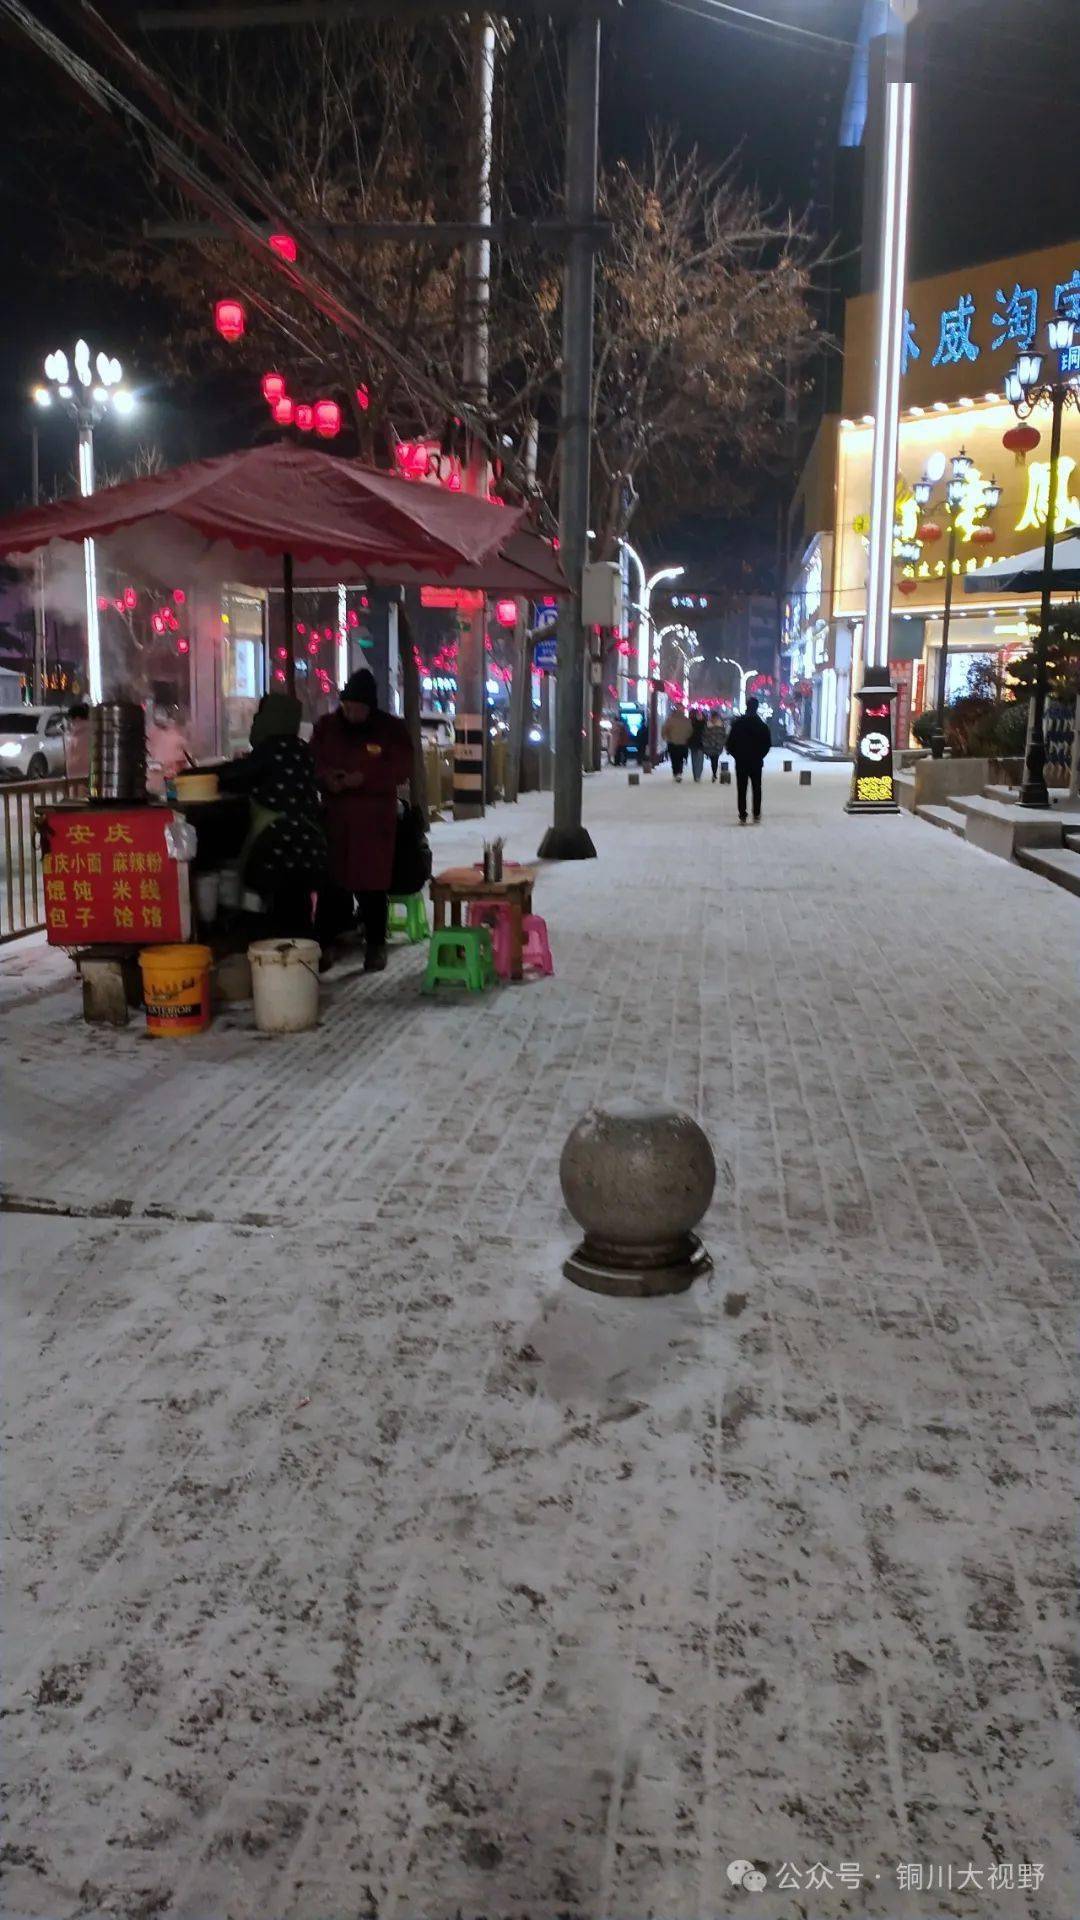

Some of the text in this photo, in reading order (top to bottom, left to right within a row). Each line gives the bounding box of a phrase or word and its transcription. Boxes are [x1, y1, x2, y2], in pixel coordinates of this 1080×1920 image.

[66, 823, 134, 845] 安庆
[112, 850, 163, 873] 麻辣粉
[47, 878, 162, 902] 馄饨 米线
[49, 906, 96, 929] 包子
